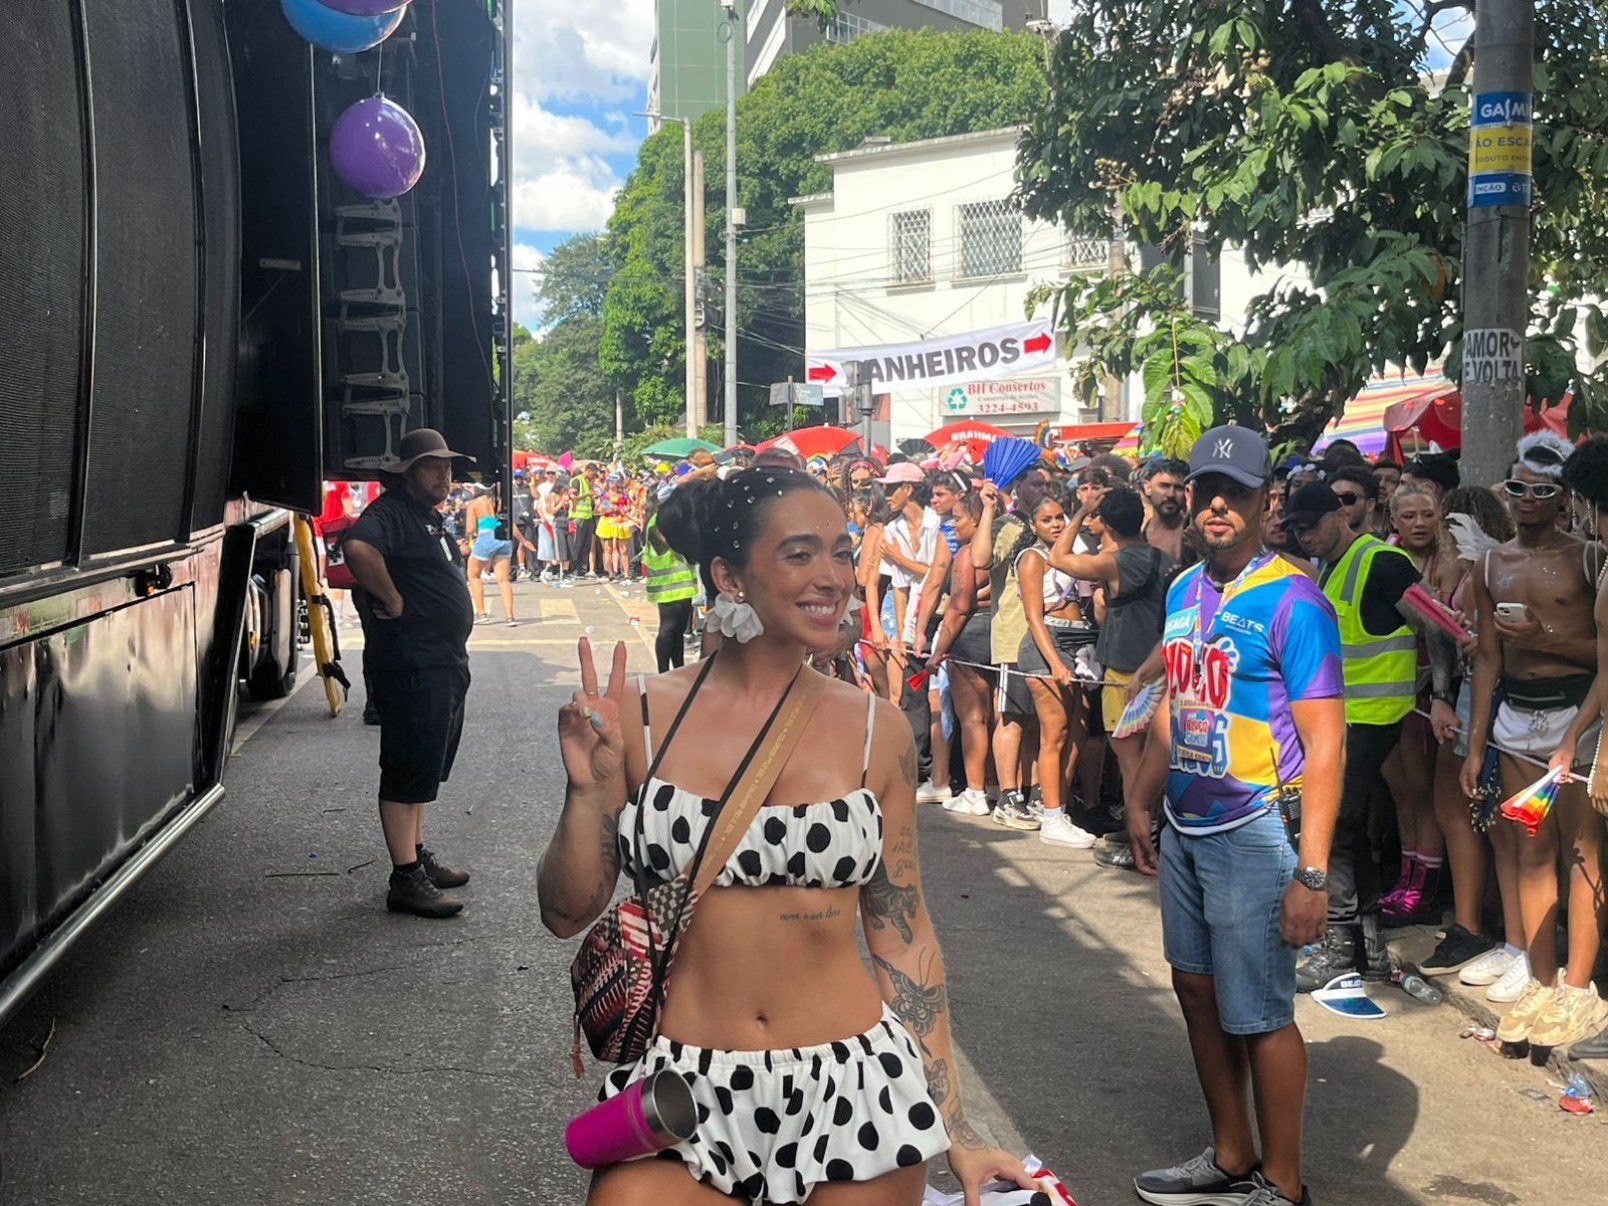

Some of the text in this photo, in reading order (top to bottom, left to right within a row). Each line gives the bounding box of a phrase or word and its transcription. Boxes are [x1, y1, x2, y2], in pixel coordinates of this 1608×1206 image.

[866, 338, 1020, 383] ANHEIROS
[968, 380, 1046, 395] BH Consertos
[978, 402, 1038, 414] 3224-4593
[1212, 438, 1234, 459] NY
